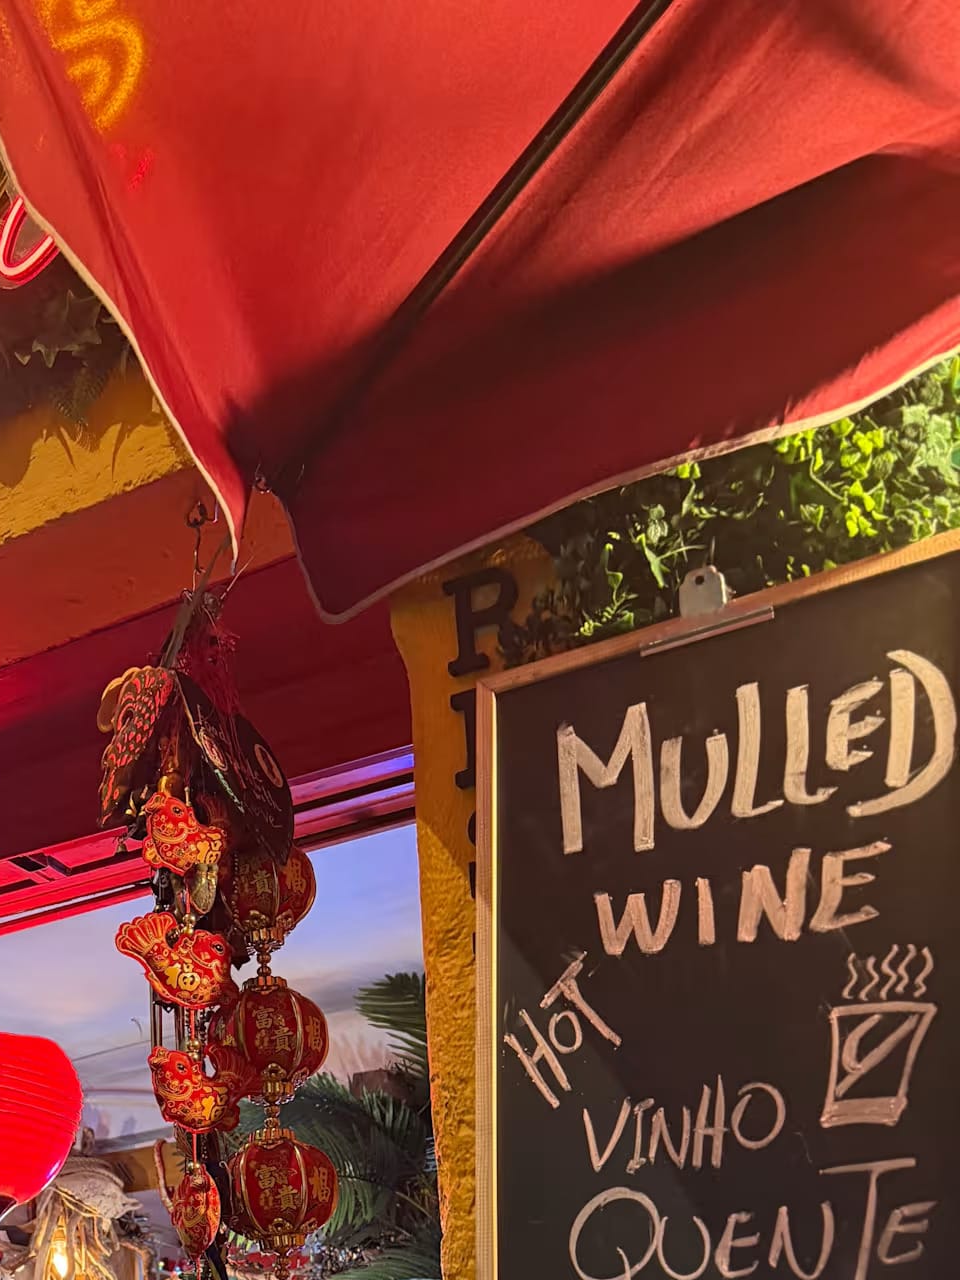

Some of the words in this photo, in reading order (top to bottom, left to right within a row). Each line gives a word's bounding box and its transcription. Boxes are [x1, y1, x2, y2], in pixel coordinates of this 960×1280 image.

[556, 648, 957, 855] MULLED
[593, 840, 893, 956] WINE
[503, 951, 623, 1110] HOT
[583, 1074, 787, 1174] VINHO
